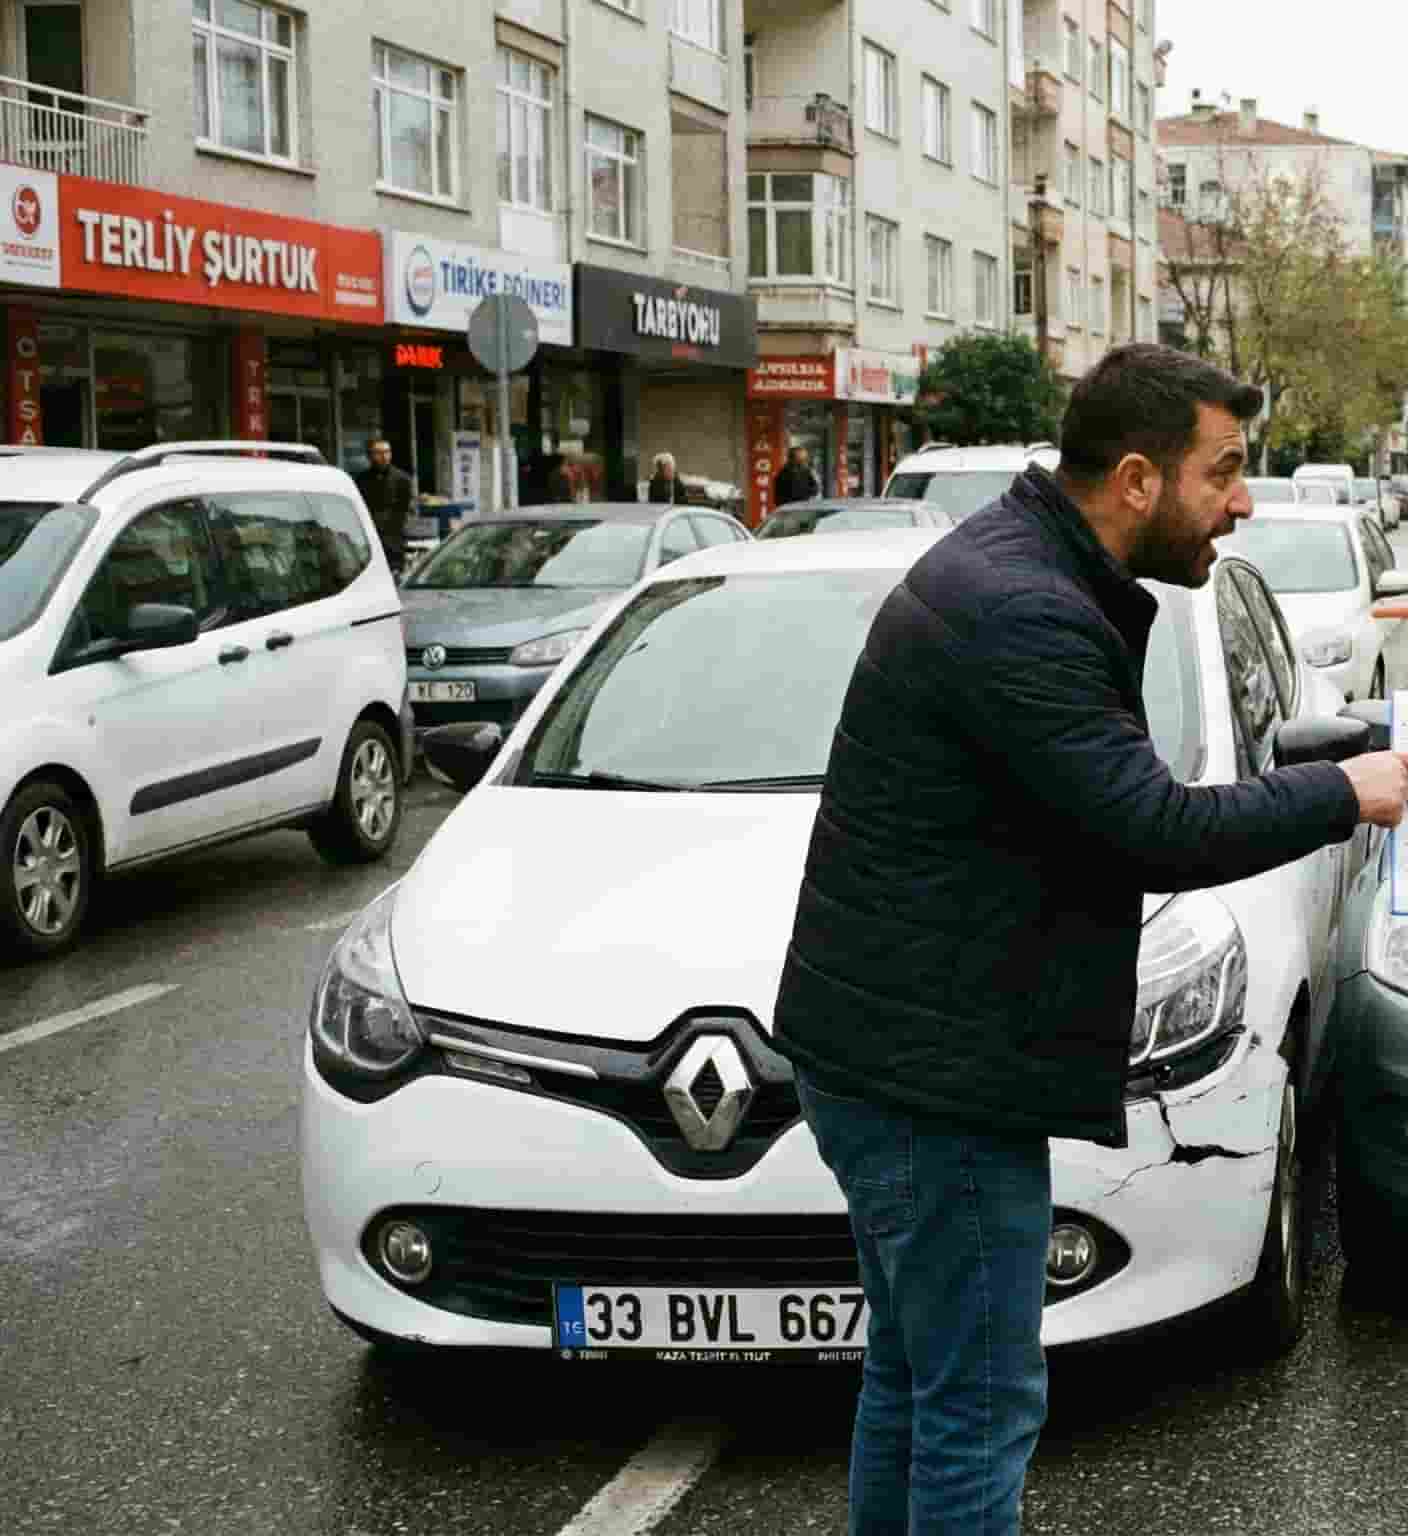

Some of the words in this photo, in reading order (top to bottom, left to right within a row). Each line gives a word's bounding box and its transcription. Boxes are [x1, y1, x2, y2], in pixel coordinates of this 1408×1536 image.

[76, 208, 197, 275] TERLİY
[202, 228, 320, 293] ŞURTUK
[586, 1293, 643, 1341] 33
[667, 1293, 756, 1342] BVL
[779, 1293, 866, 1342] 667
